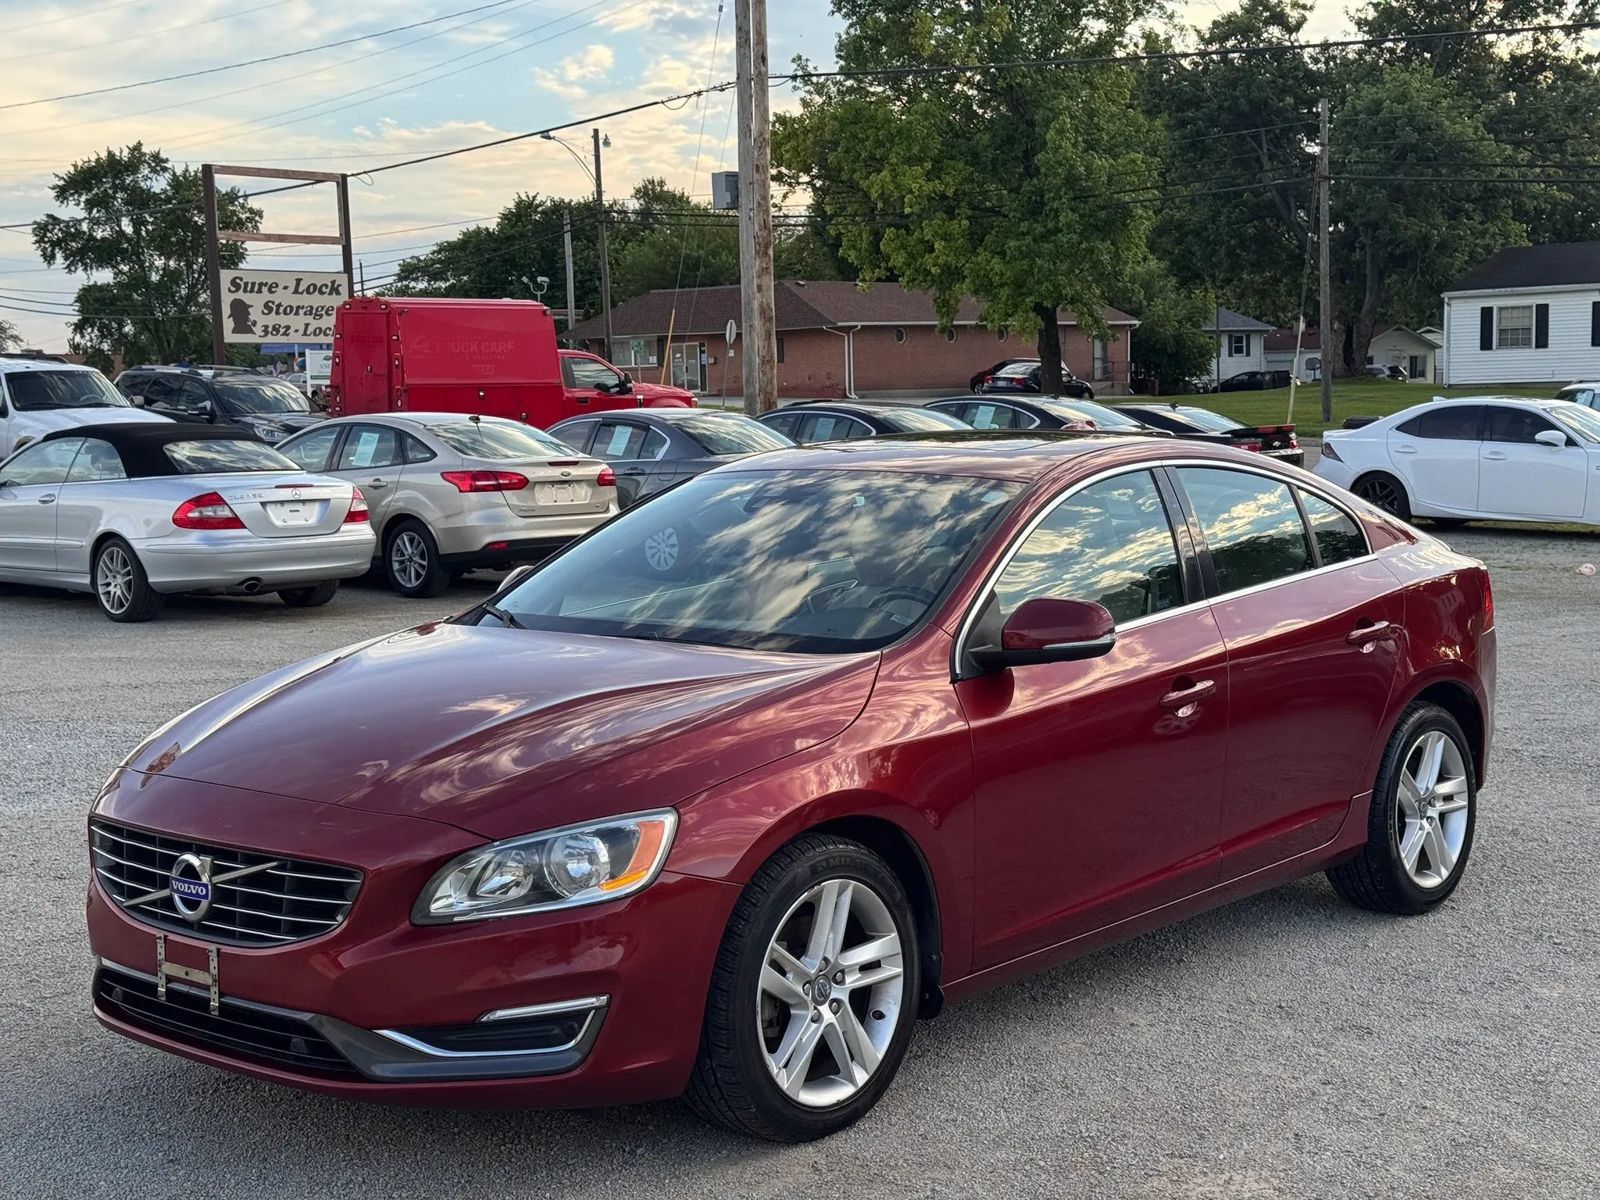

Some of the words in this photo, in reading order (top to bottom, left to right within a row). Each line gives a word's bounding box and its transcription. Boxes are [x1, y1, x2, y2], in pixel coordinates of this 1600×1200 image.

[228, 276, 279, 294] Sure
[292, 278, 342, 296] Lock
[261, 300, 334, 320] Storage
[259, 323, 291, 338] 382
[172, 880, 206, 896] VOLVO
